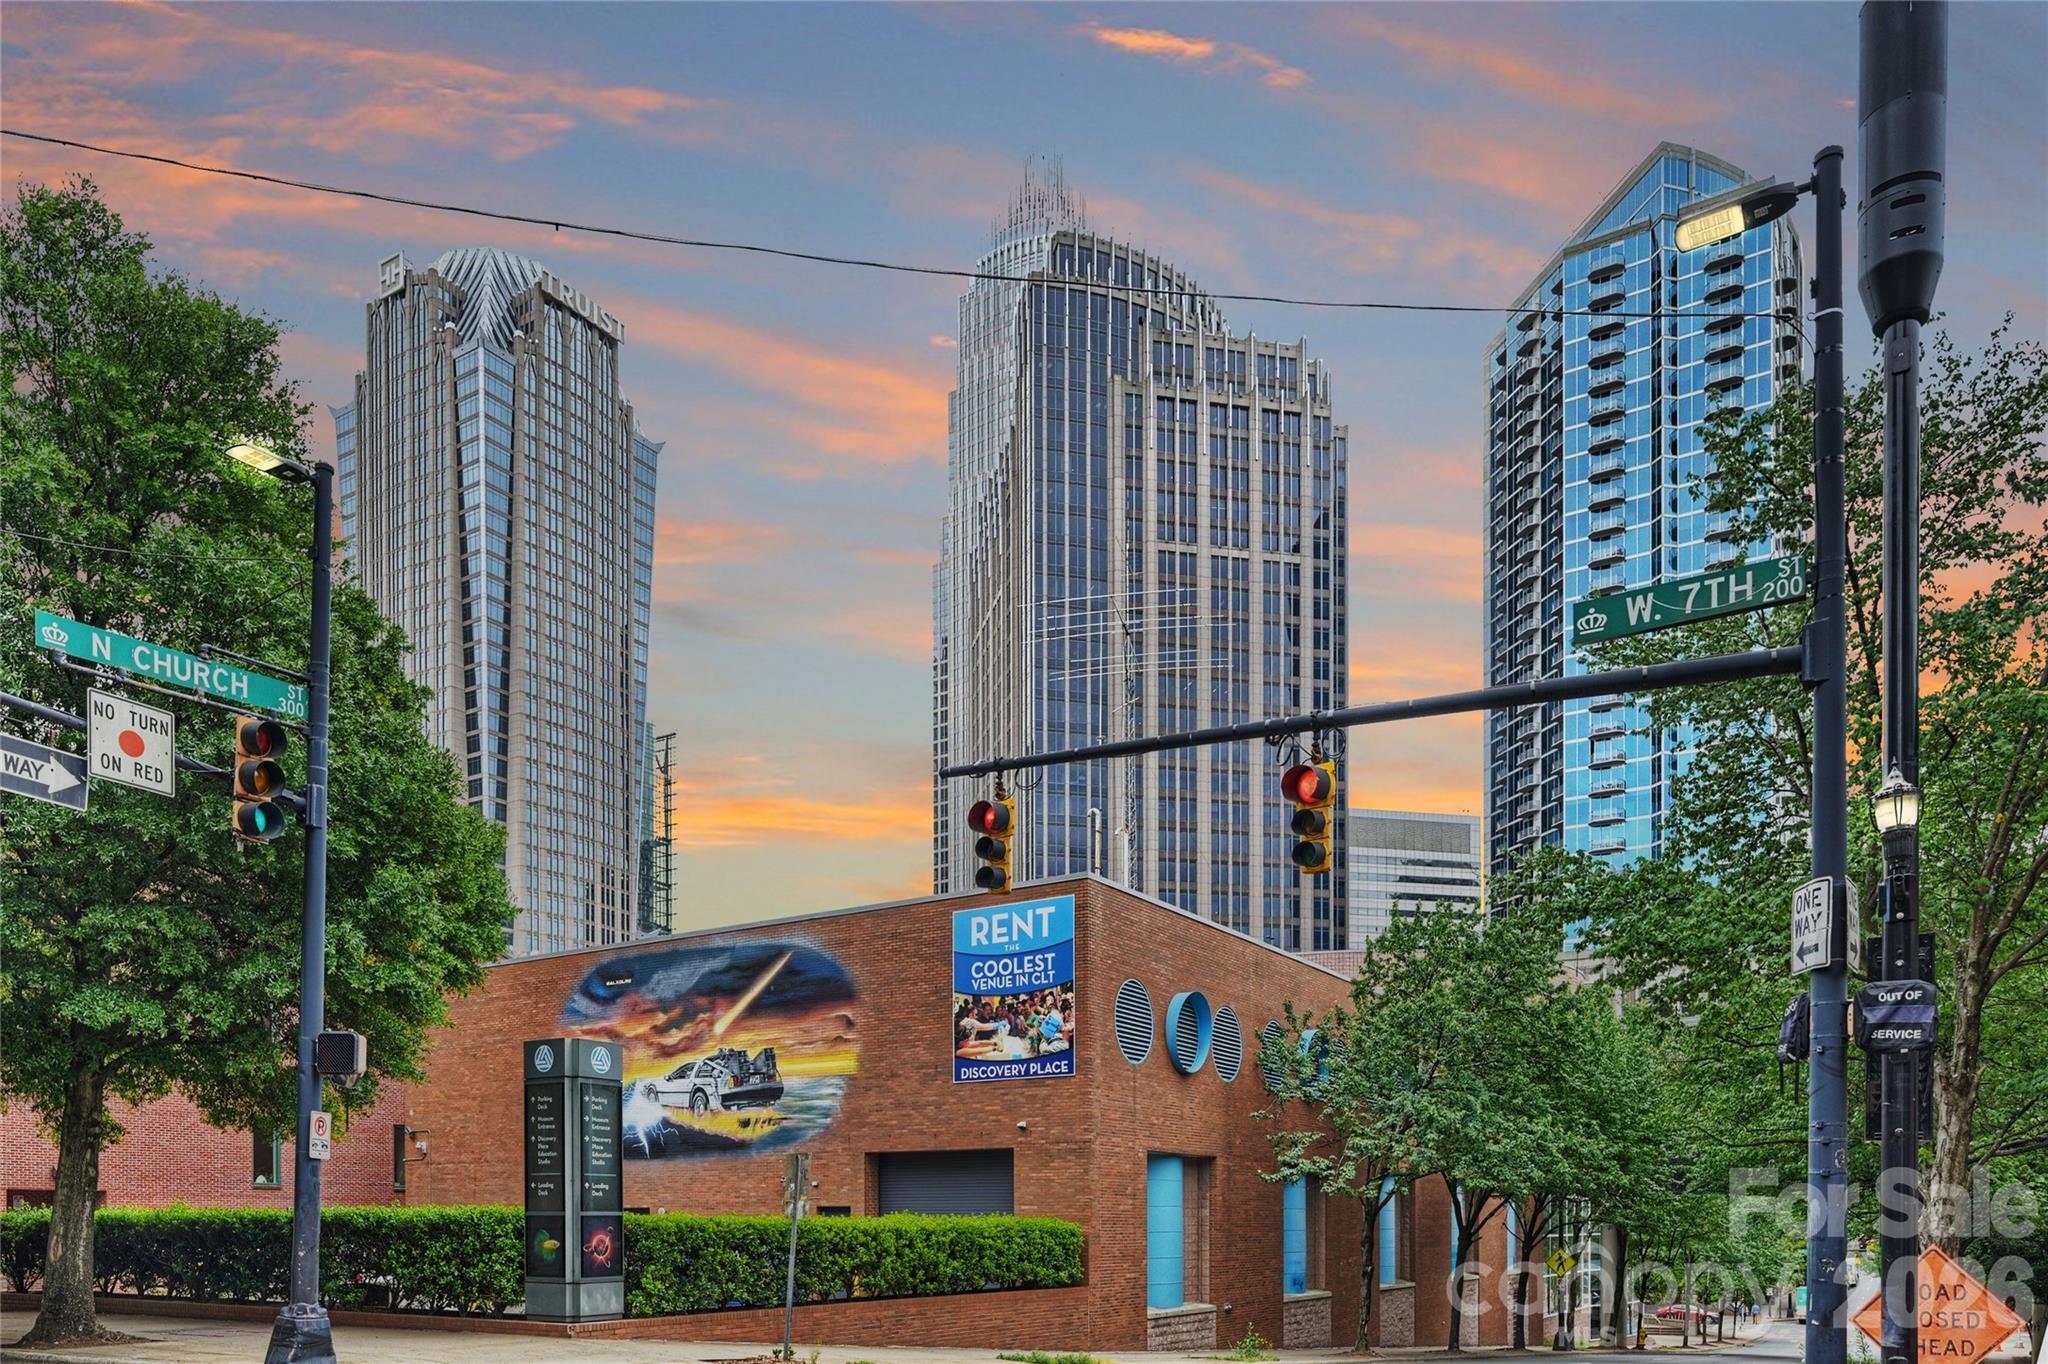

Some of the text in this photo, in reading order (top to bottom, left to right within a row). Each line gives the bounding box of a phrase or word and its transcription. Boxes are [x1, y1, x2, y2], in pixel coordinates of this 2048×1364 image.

[541, 268, 625, 345] TRUIST
[1778, 557, 1801, 578] ST
[1626, 571, 1753, 626] W. 7TH
[1762, 576, 1803, 602] 200
[92, 632, 249, 698] N CHURCH
[287, 685, 304, 702] ST
[94, 700, 169, 737] NO TURN
[278, 697, 304, 717] 300
[4, 753, 45, 780] WAY
[101, 753, 164, 784] ON RED
[1796, 887, 1822, 914] ONE
[971, 906, 1056, 947] RENT
[1795, 911, 1823, 939] WAY
[1004, 943, 1020, 952] THE
[971, 953, 1056, 979] COOLEST
[971, 970, 1056, 991] VENUE IN CLT
[1878, 990, 1924, 1002] OUT OF
[1871, 1029, 1922, 1040] SERVICE
[961, 1060, 1070, 1080] DISCOVERY PLACE
[1919, 1283, 1968, 1301] OAD
[1919, 1311, 1981, 1329] OSED
[1918, 1339, 1976, 1357] HEAD
